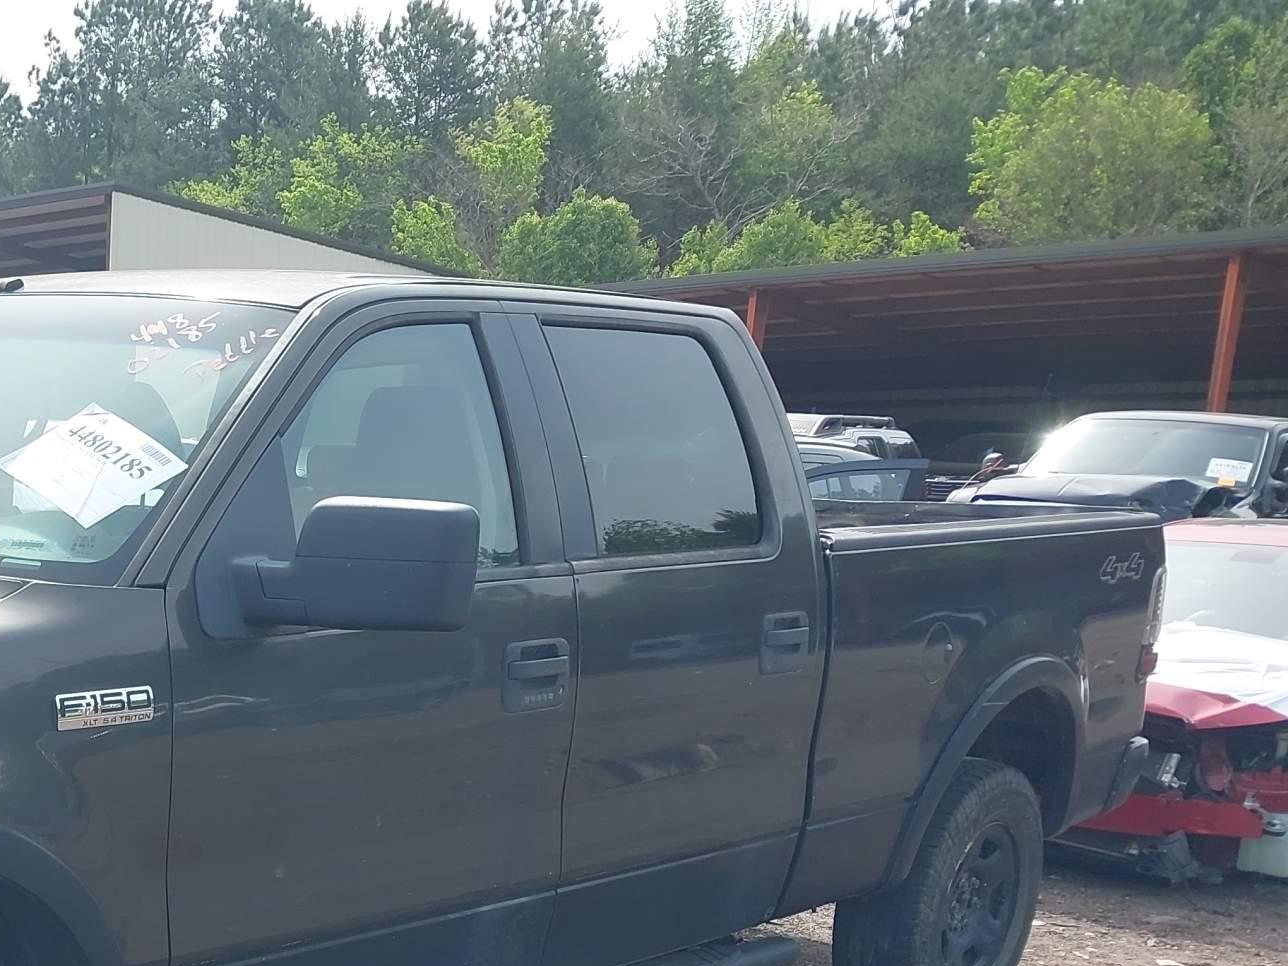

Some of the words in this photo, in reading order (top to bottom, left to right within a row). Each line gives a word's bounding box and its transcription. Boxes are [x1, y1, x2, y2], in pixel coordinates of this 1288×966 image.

[68, 425, 153, 480] 44802185
[1099, 552, 1145, 584] 4x4
[82, 718, 98, 727] XLT
[120, 712, 152, 723] TRITON
